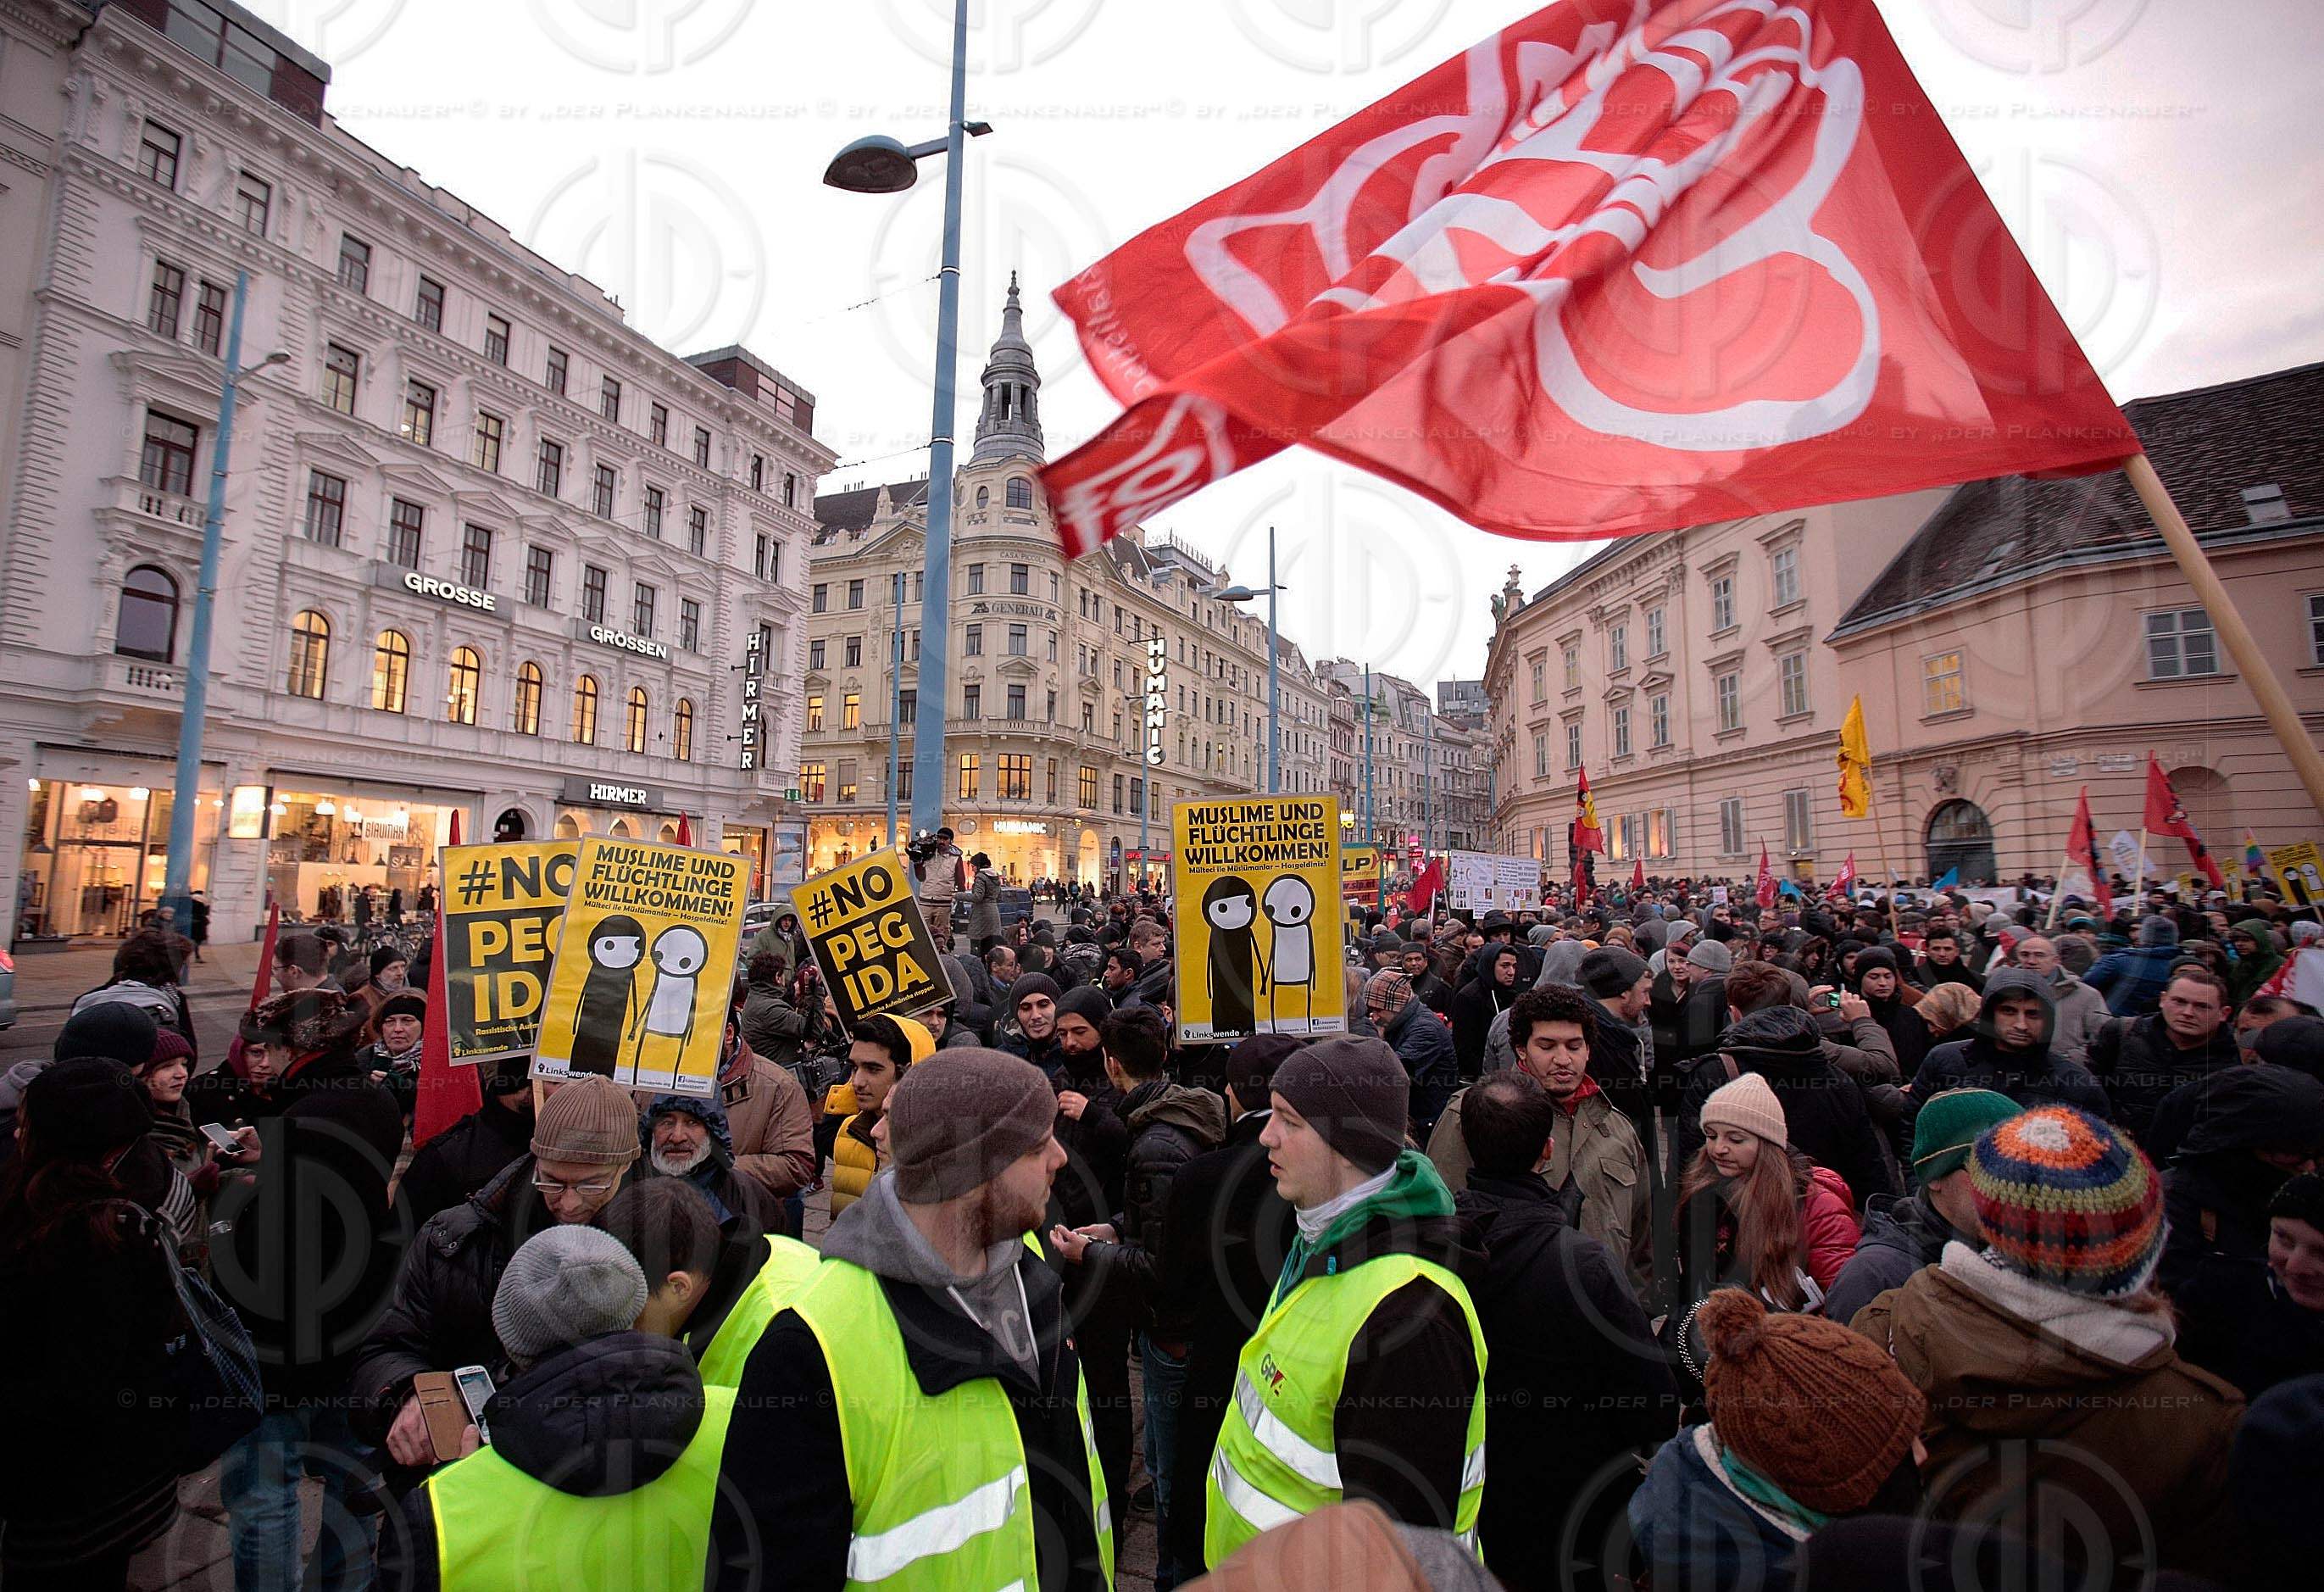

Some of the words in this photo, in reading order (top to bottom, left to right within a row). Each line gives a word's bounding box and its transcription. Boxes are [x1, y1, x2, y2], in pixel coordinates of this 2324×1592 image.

[1020, 554, 1047, 564] PICCOLA
[403, 571, 496, 612] GROSSE
[992, 602, 1043, 617] GENERALI
[589, 625, 668, 660] GRÖSSEN
[740, 632, 762, 771] HIRMER
[1147, 637, 1167, 765] HUMANIC
[589, 782, 647, 805] HIRMER
[992, 821, 1048, 835] HUMANIC
[1187, 804, 1274, 826] MUSLIME
[1281, 803, 1324, 821] UND
[1189, 822, 1325, 845] FLÜCHTLINGE
[596, 844, 687, 872] MUSLIME
[690, 860, 736, 879] UND
[1185, 841, 1329, 865] WILLKOMMEN!
[1343, 857, 1370, 871] LP
[458, 853, 576, 905] #NO
[591, 864, 734, 899] FLÜCHTLINGE
[583, 882, 735, 918] WILLKOMMEN!
[584, 900, 612, 910] Mülteci
[807, 865, 894, 929] #NO
[826, 911, 915, 972] PEG
[842, 950, 931, 1012] IDA
[1192, 1030, 1240, 1038] Linkswende
[462, 1044, 509, 1056] Linkswende
